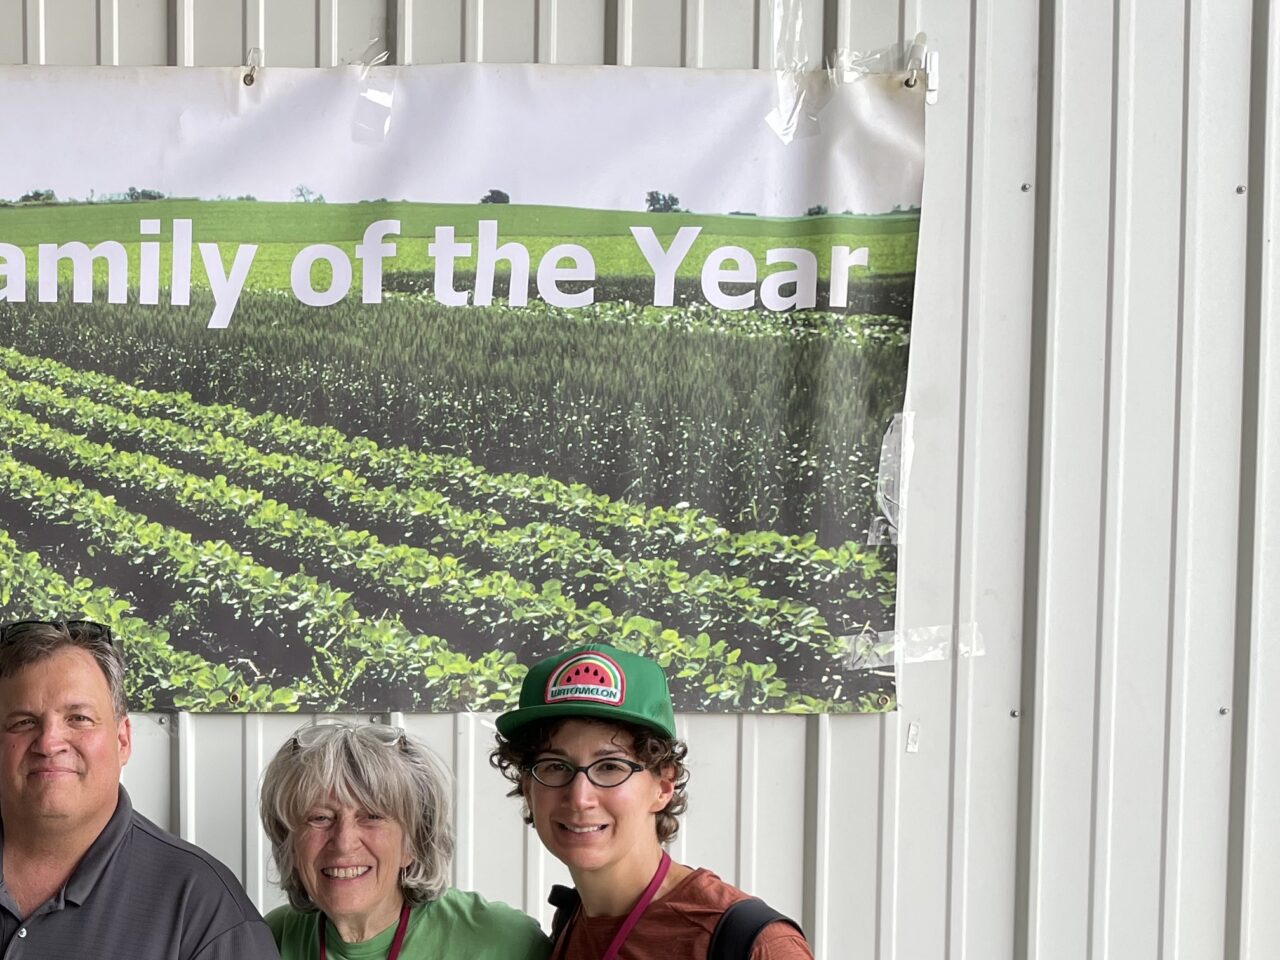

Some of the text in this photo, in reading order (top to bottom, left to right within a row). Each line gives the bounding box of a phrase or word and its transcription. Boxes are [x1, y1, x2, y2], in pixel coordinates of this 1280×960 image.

[290, 219, 401, 307] of
[428, 220, 596, 309] the
[629, 226, 869, 312] Year
[551, 687, 617, 699] WATERMELON
